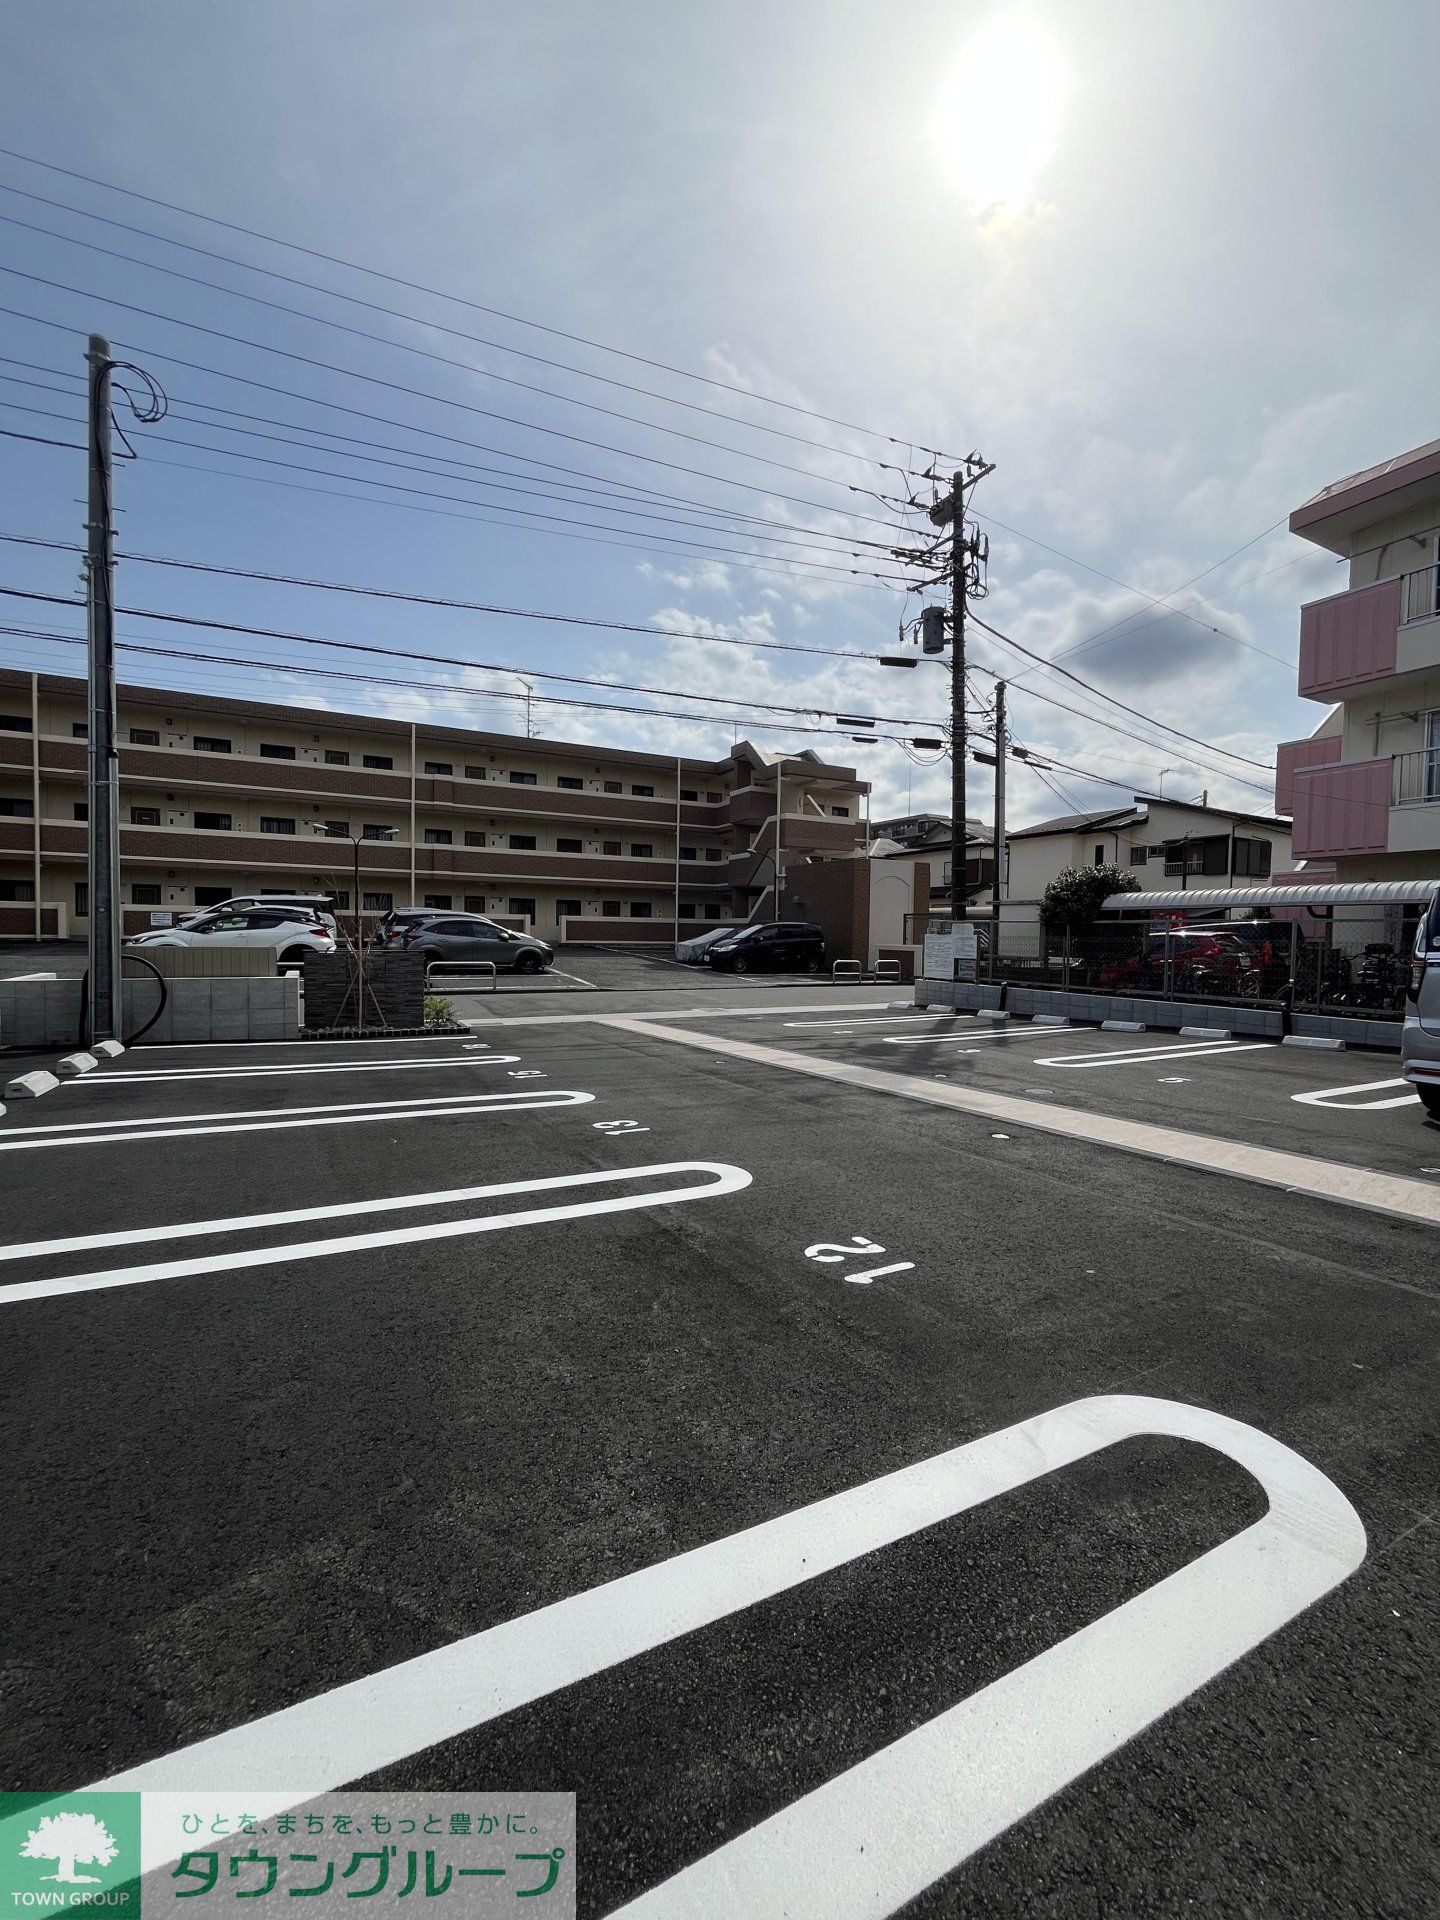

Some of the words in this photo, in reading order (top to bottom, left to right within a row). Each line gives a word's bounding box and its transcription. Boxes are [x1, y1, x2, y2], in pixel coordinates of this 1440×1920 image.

[507, 1070, 548, 1079] 15
[592, 1119, 651, 1136] 13
[804, 1236, 915, 1284] 12
